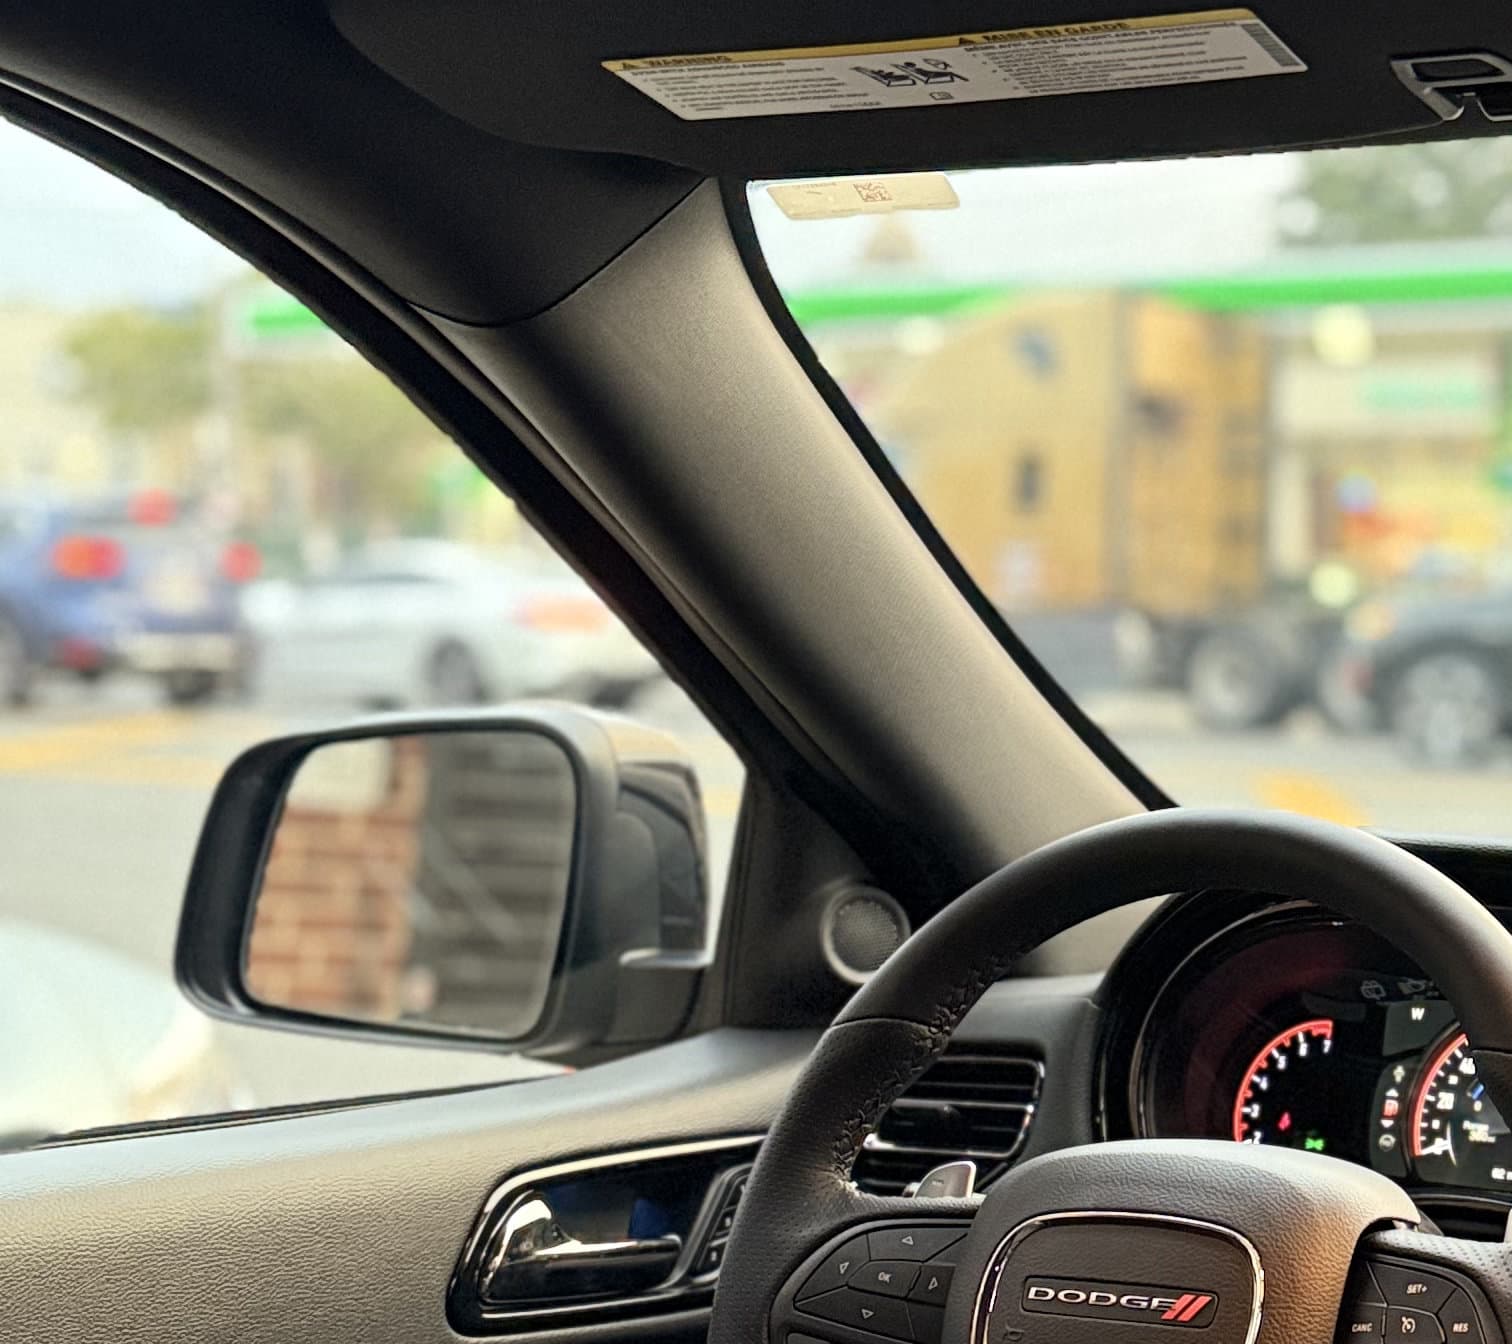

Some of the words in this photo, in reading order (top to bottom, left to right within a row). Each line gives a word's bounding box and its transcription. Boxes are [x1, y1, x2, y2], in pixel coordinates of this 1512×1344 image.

[1411, 1007, 1425, 1021] W
[878, 1271, 892, 1283] OK
[1028, 1286, 1178, 1312] DODGE
[1352, 1322, 1373, 1333] CANC
[1452, 1322, 1469, 1333] RES
